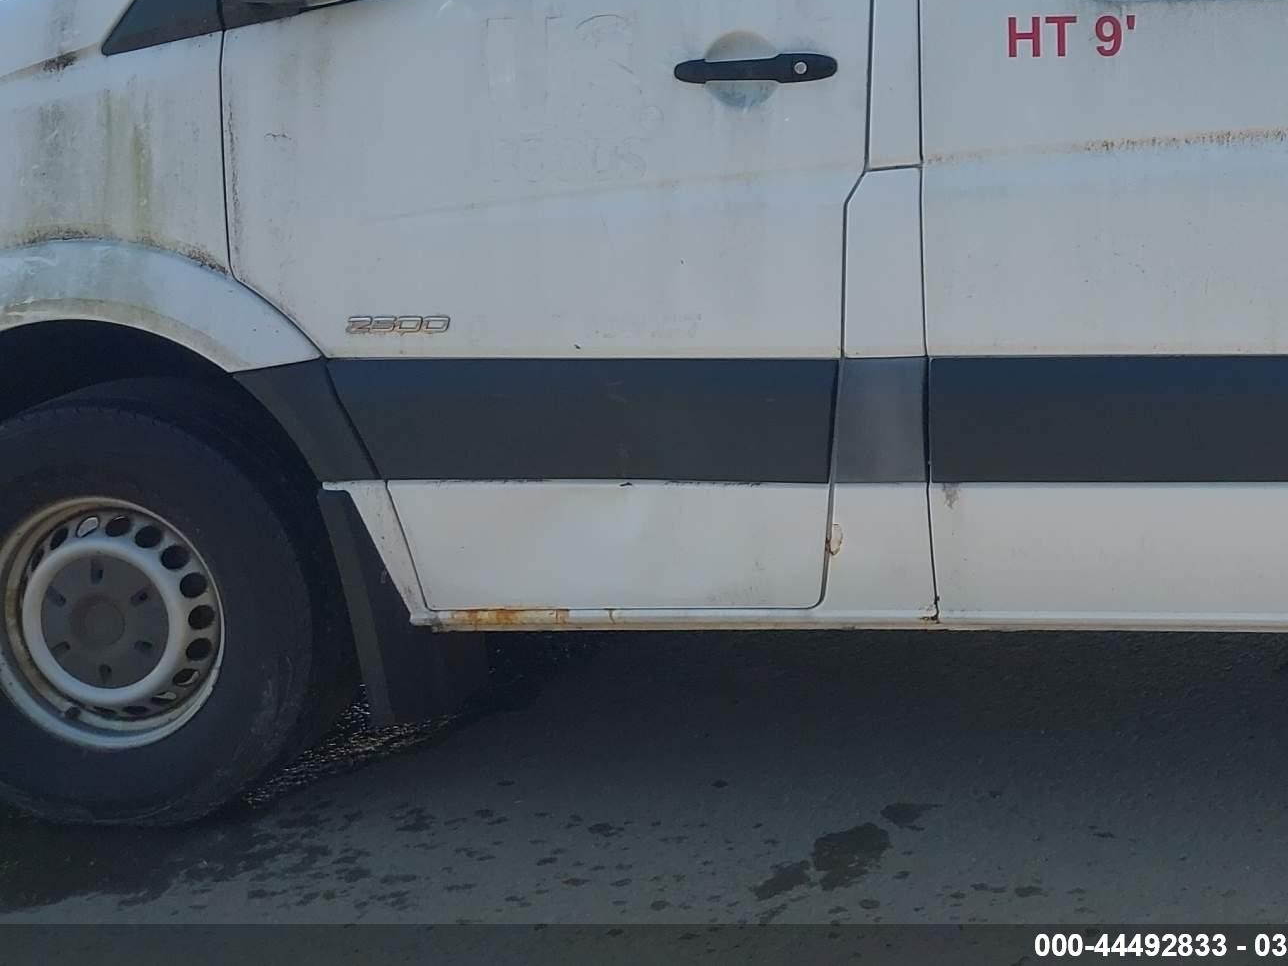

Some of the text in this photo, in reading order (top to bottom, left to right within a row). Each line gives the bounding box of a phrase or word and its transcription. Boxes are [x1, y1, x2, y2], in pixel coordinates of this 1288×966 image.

[1008, 15, 1135, 57] HT 9'
[345, 316, 450, 334] 2500
